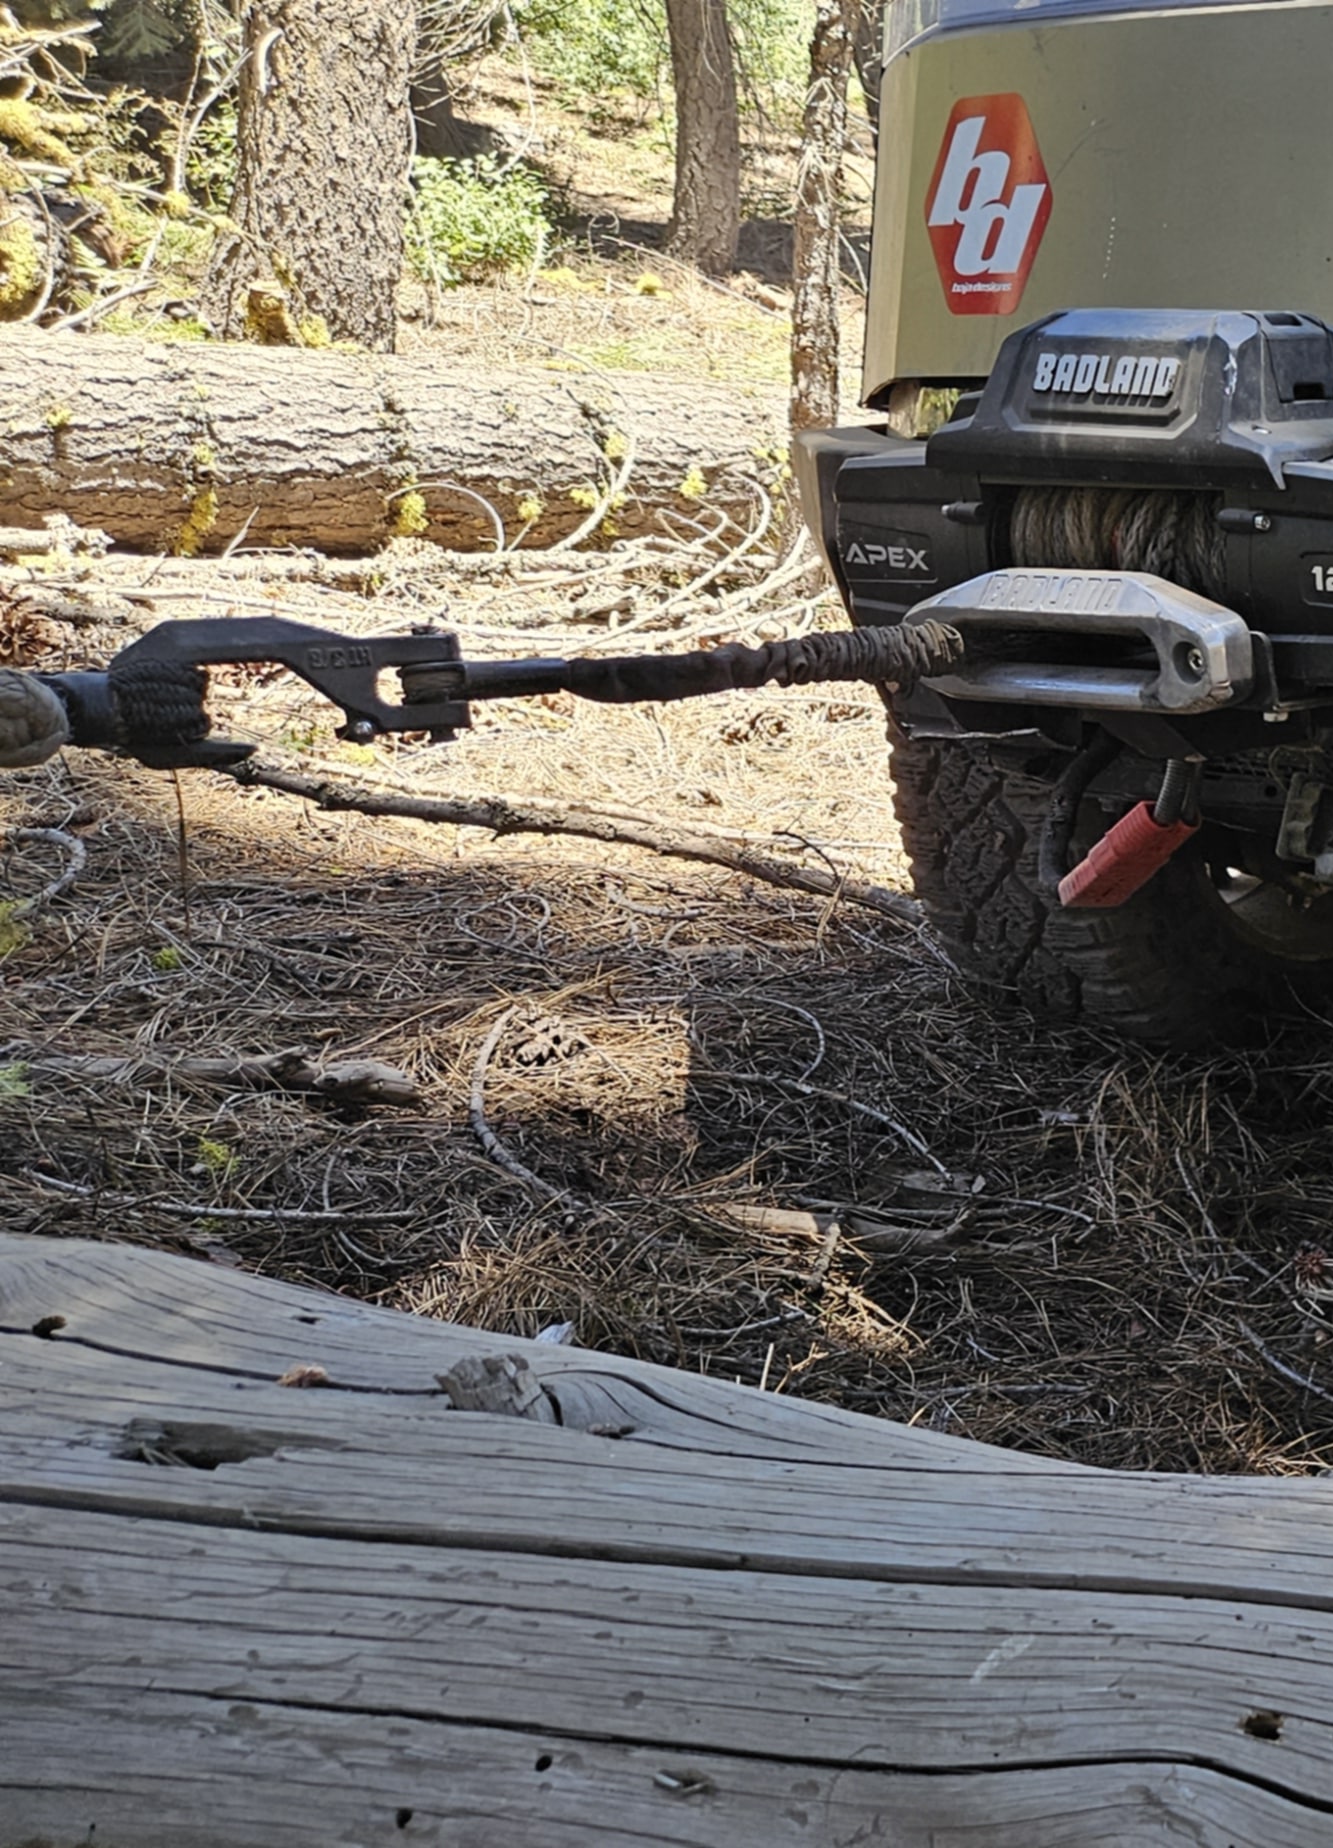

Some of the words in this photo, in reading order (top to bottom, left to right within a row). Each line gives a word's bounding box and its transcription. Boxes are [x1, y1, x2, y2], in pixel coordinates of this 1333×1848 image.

[1033, 353, 1181, 396] BADLAND
[845, 542, 930, 571] APEX
[979, 574, 1123, 613] BADLAND
